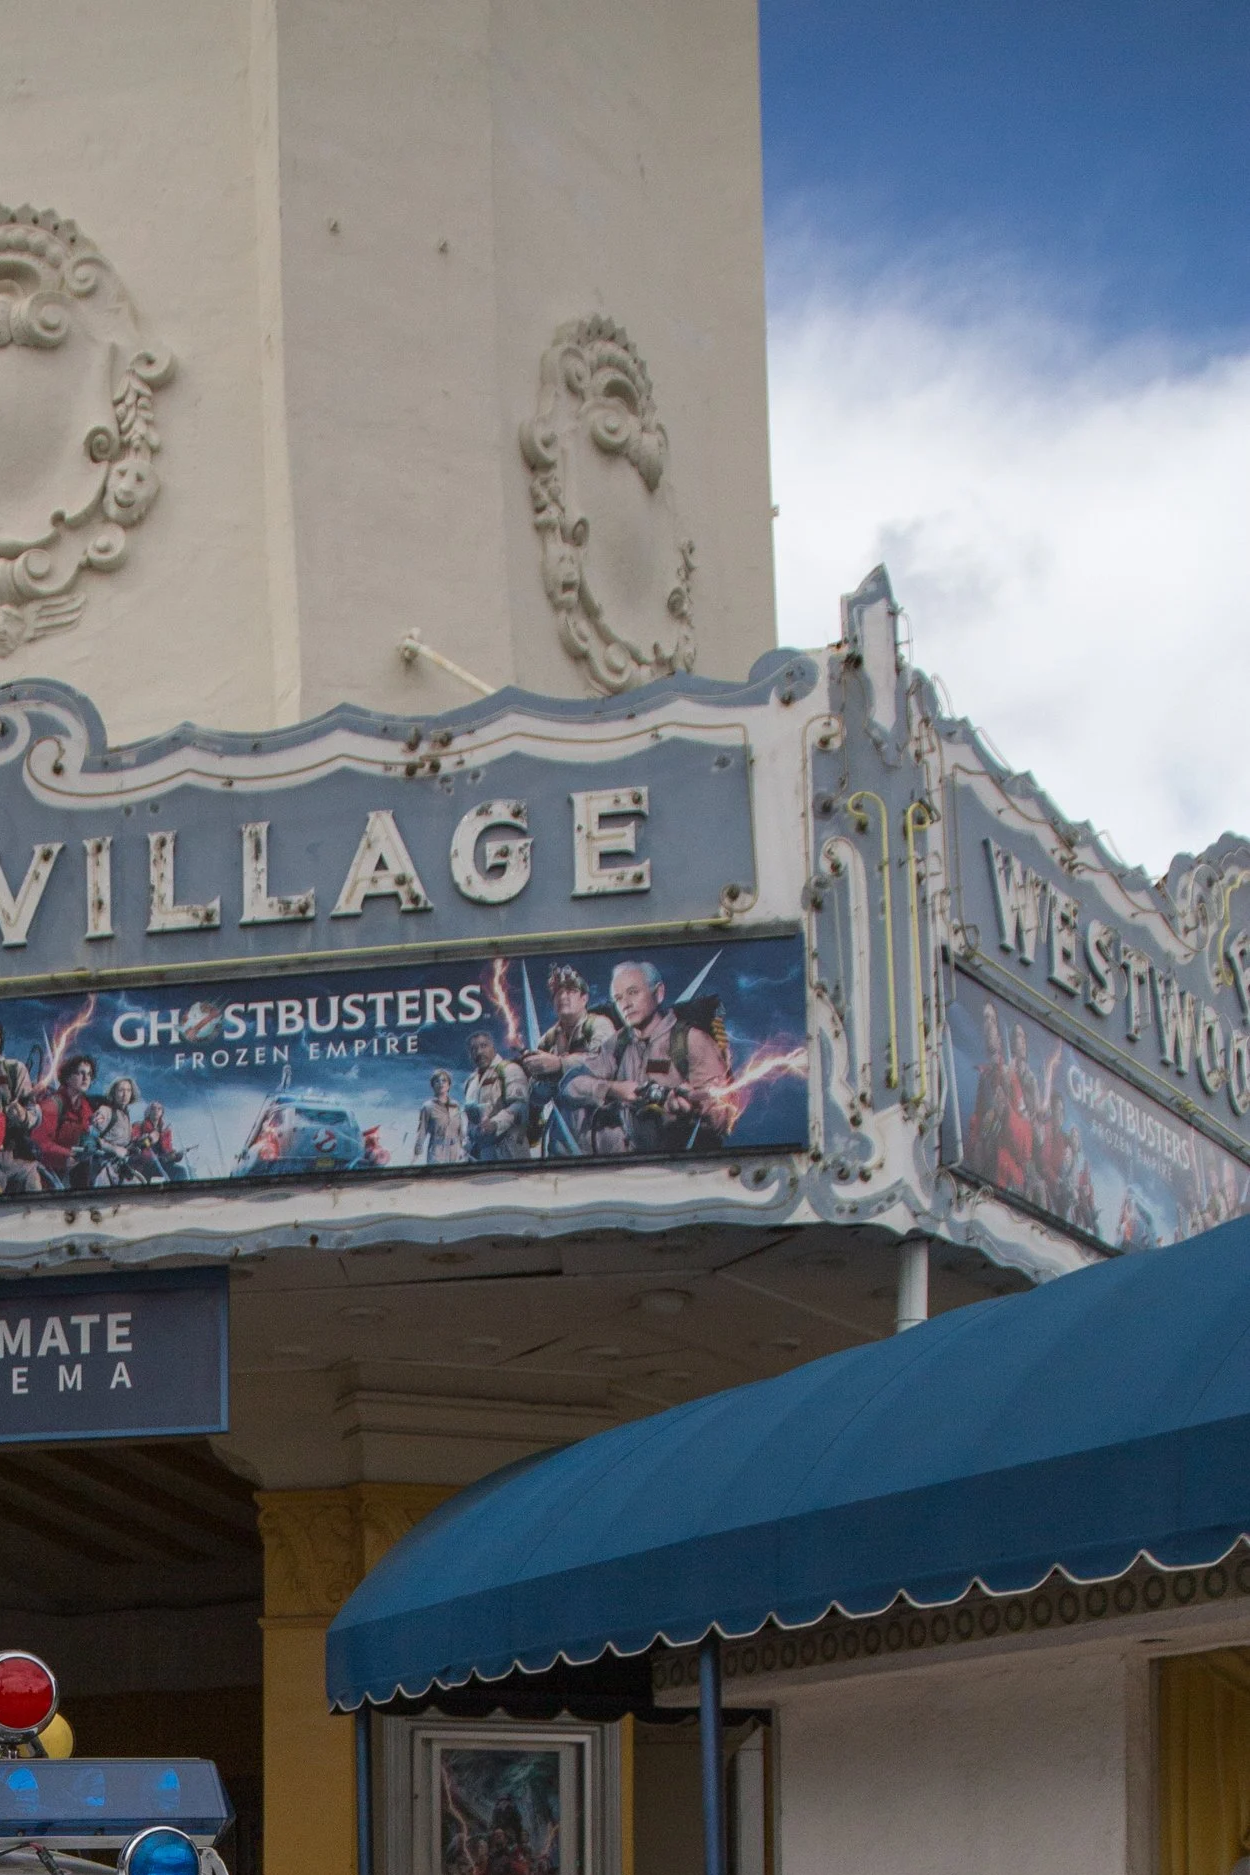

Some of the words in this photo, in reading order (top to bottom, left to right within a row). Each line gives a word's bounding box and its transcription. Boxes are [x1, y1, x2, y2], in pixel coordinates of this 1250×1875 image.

[112, 984, 484, 1049] GHOSTBUSTERS
[174, 1045, 290, 1071] FROZEN
[309, 1035, 419, 1060] EMPIRE
